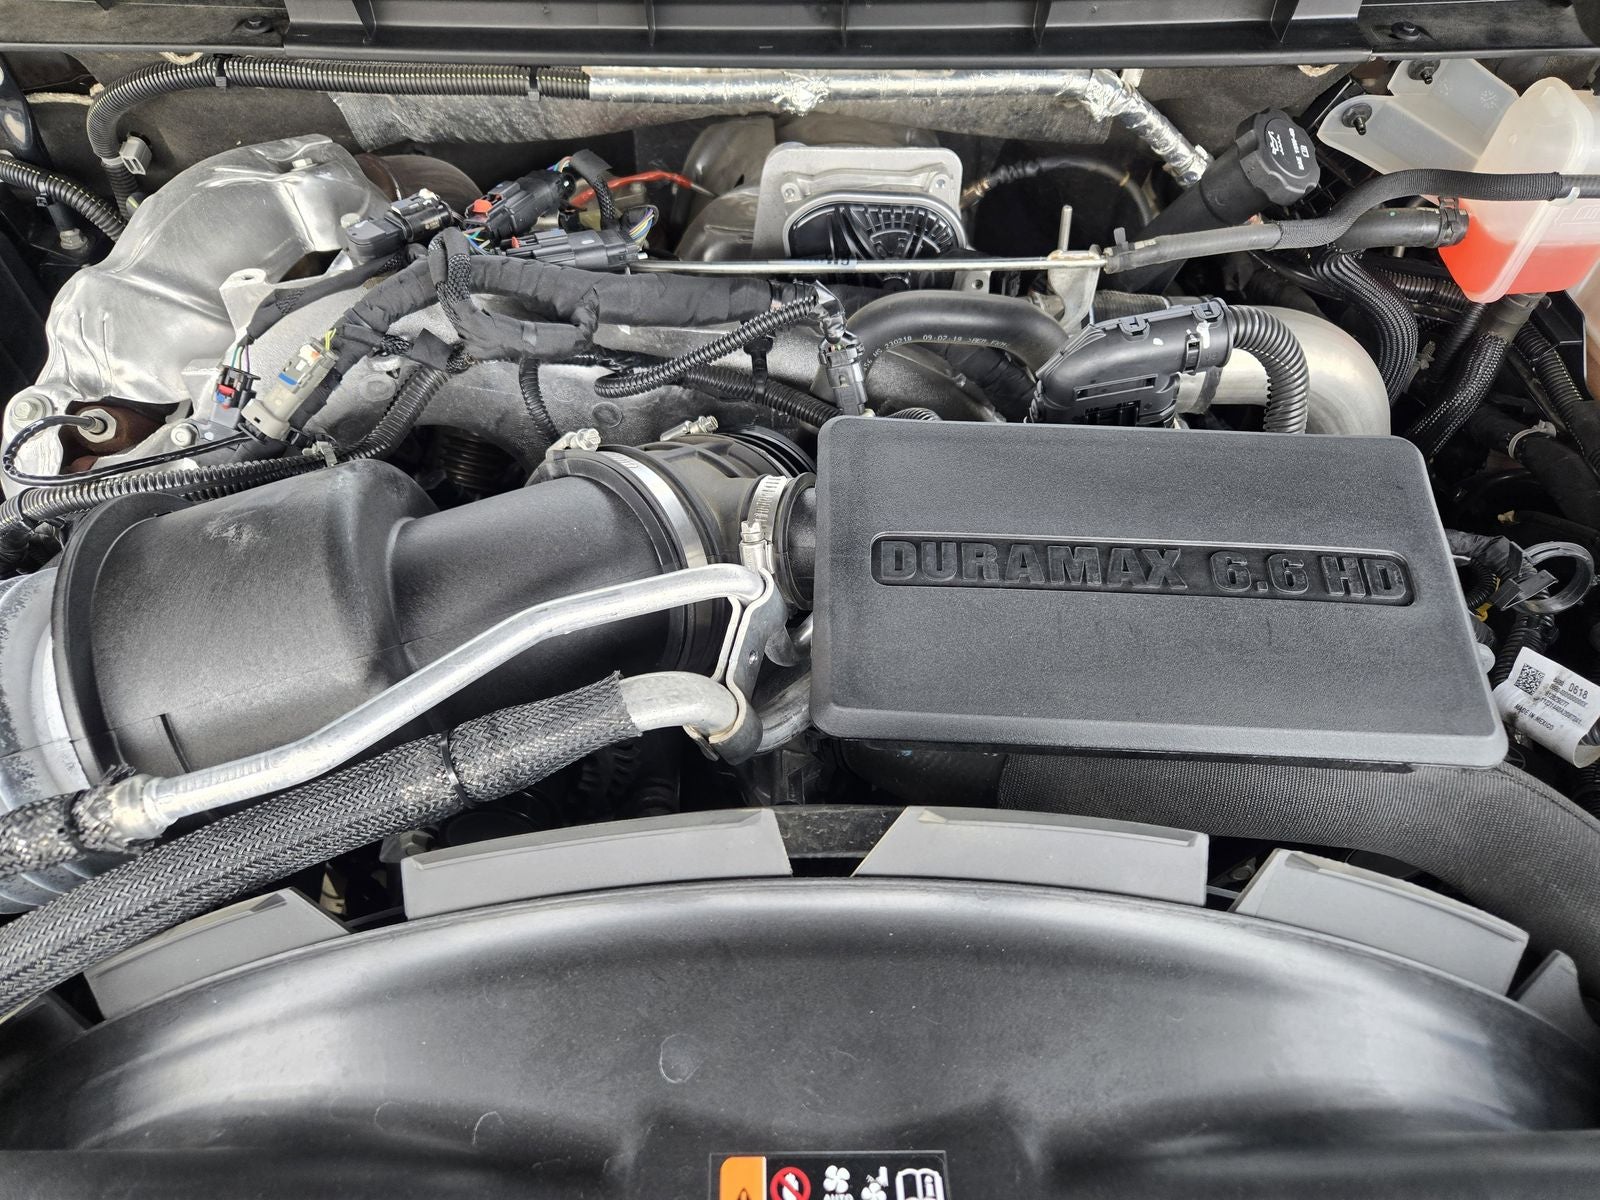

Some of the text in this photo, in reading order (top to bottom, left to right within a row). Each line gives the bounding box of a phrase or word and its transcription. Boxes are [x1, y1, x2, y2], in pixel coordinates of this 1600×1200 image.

[880, 540, 1407, 600] DURAMAX 6.6 HD
[1514, 703, 1529, 715] MADE
[1535, 716, 1554, 730] MEXICO
